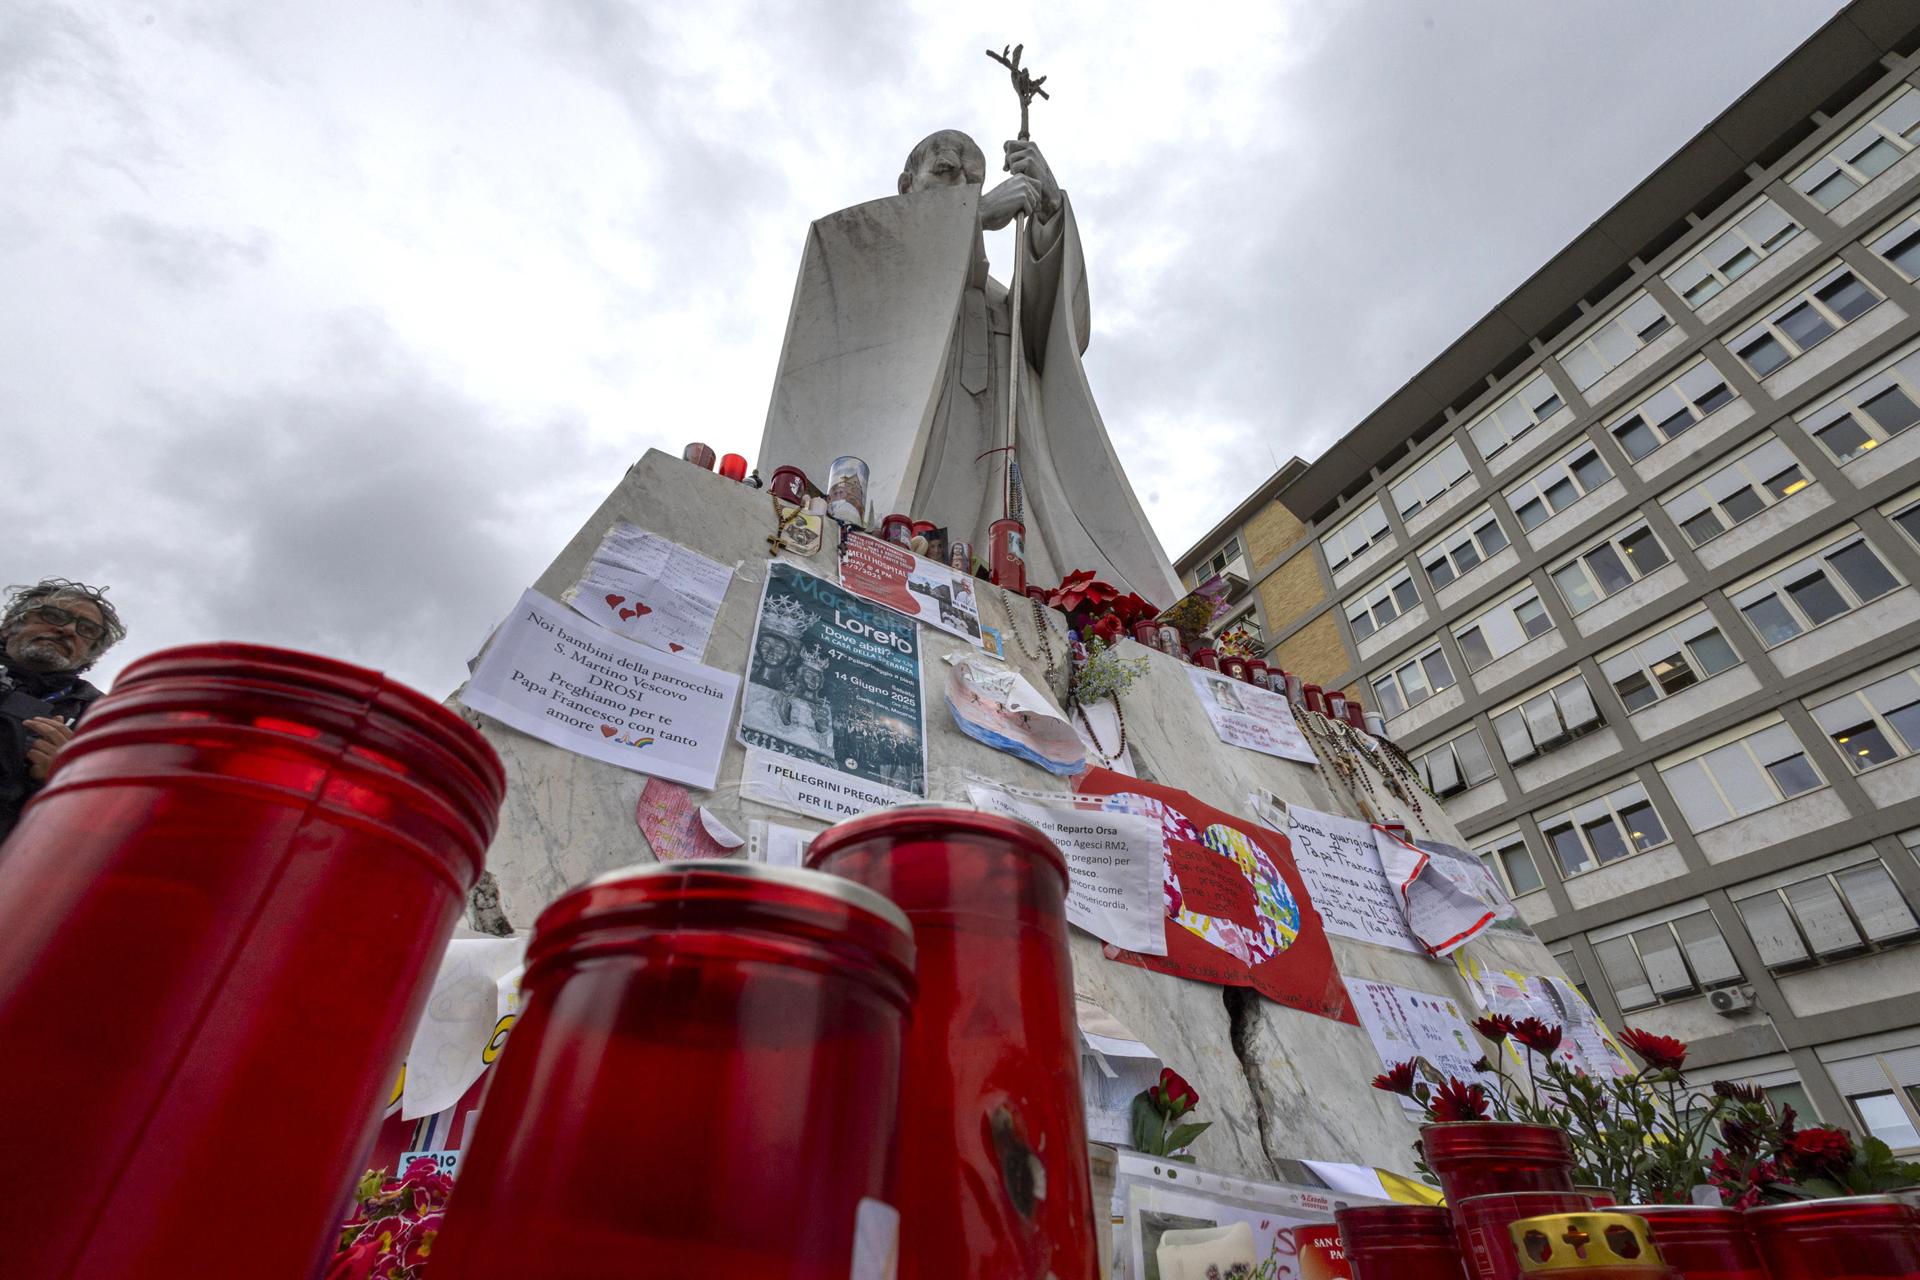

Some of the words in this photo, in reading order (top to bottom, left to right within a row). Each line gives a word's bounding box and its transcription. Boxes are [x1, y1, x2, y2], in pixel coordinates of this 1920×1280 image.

[872, 558, 907, 578] HOSPITAL
[834, 610, 913, 654] Loreto
[527, 612, 555, 634] Noi
[556, 627, 614, 663] bambini
[616, 656, 650, 676] della
[652, 672, 724, 700] parrocchia
[821, 634, 829, 642] LA
[832, 638, 851, 650] CASA
[853, 647, 876, 660] DELLA
[878, 655, 914, 676] SPERANZA
[554, 642, 566, 656] S.
[569, 651, 628, 682] Martino
[633, 676, 688, 702] Vescovo
[548, 671, 626, 712] Preghiamo
[629, 706, 656, 720] per
[658, 713, 673, 726] te
[588, 674, 644, 702] DROSI
[834, 671, 848, 682] 14
[850, 676, 889, 697] Giugno
[891, 691, 916, 708] 2025
[510, 670, 547, 696] Papa
[550, 689, 625, 726] Francesco
[628, 721, 656, 735] con
[658, 730, 698, 748] tanto
[546, 706, 594, 732] amore
[768, 764, 772, 773] I
[774, 766, 840, 793] PELLEGRINI
[798, 792, 821, 806] PER
[824, 800, 834, 810] IL
[836, 803, 864, 816] PAP
[1042, 822, 1055, 832] del
[1056, 824, 1094, 835] Reparto
[1096, 826, 1118, 836] Orsa
[1074, 840, 1103, 851] Agesci
[1104, 842, 1129, 852] RM2,
[1068, 866, 1100, 878] ncesco.
[1072, 854, 1112, 866] pregano)
[1114, 858, 1131, 867] per
[1076, 892, 1129, 911] misericordia,
[1098, 886, 1123, 896] come
[1322, 906, 1358, 930] Roma
[1314, 1238, 1332, 1248] SAN
[1334, 1238, 1344, 1246] G
